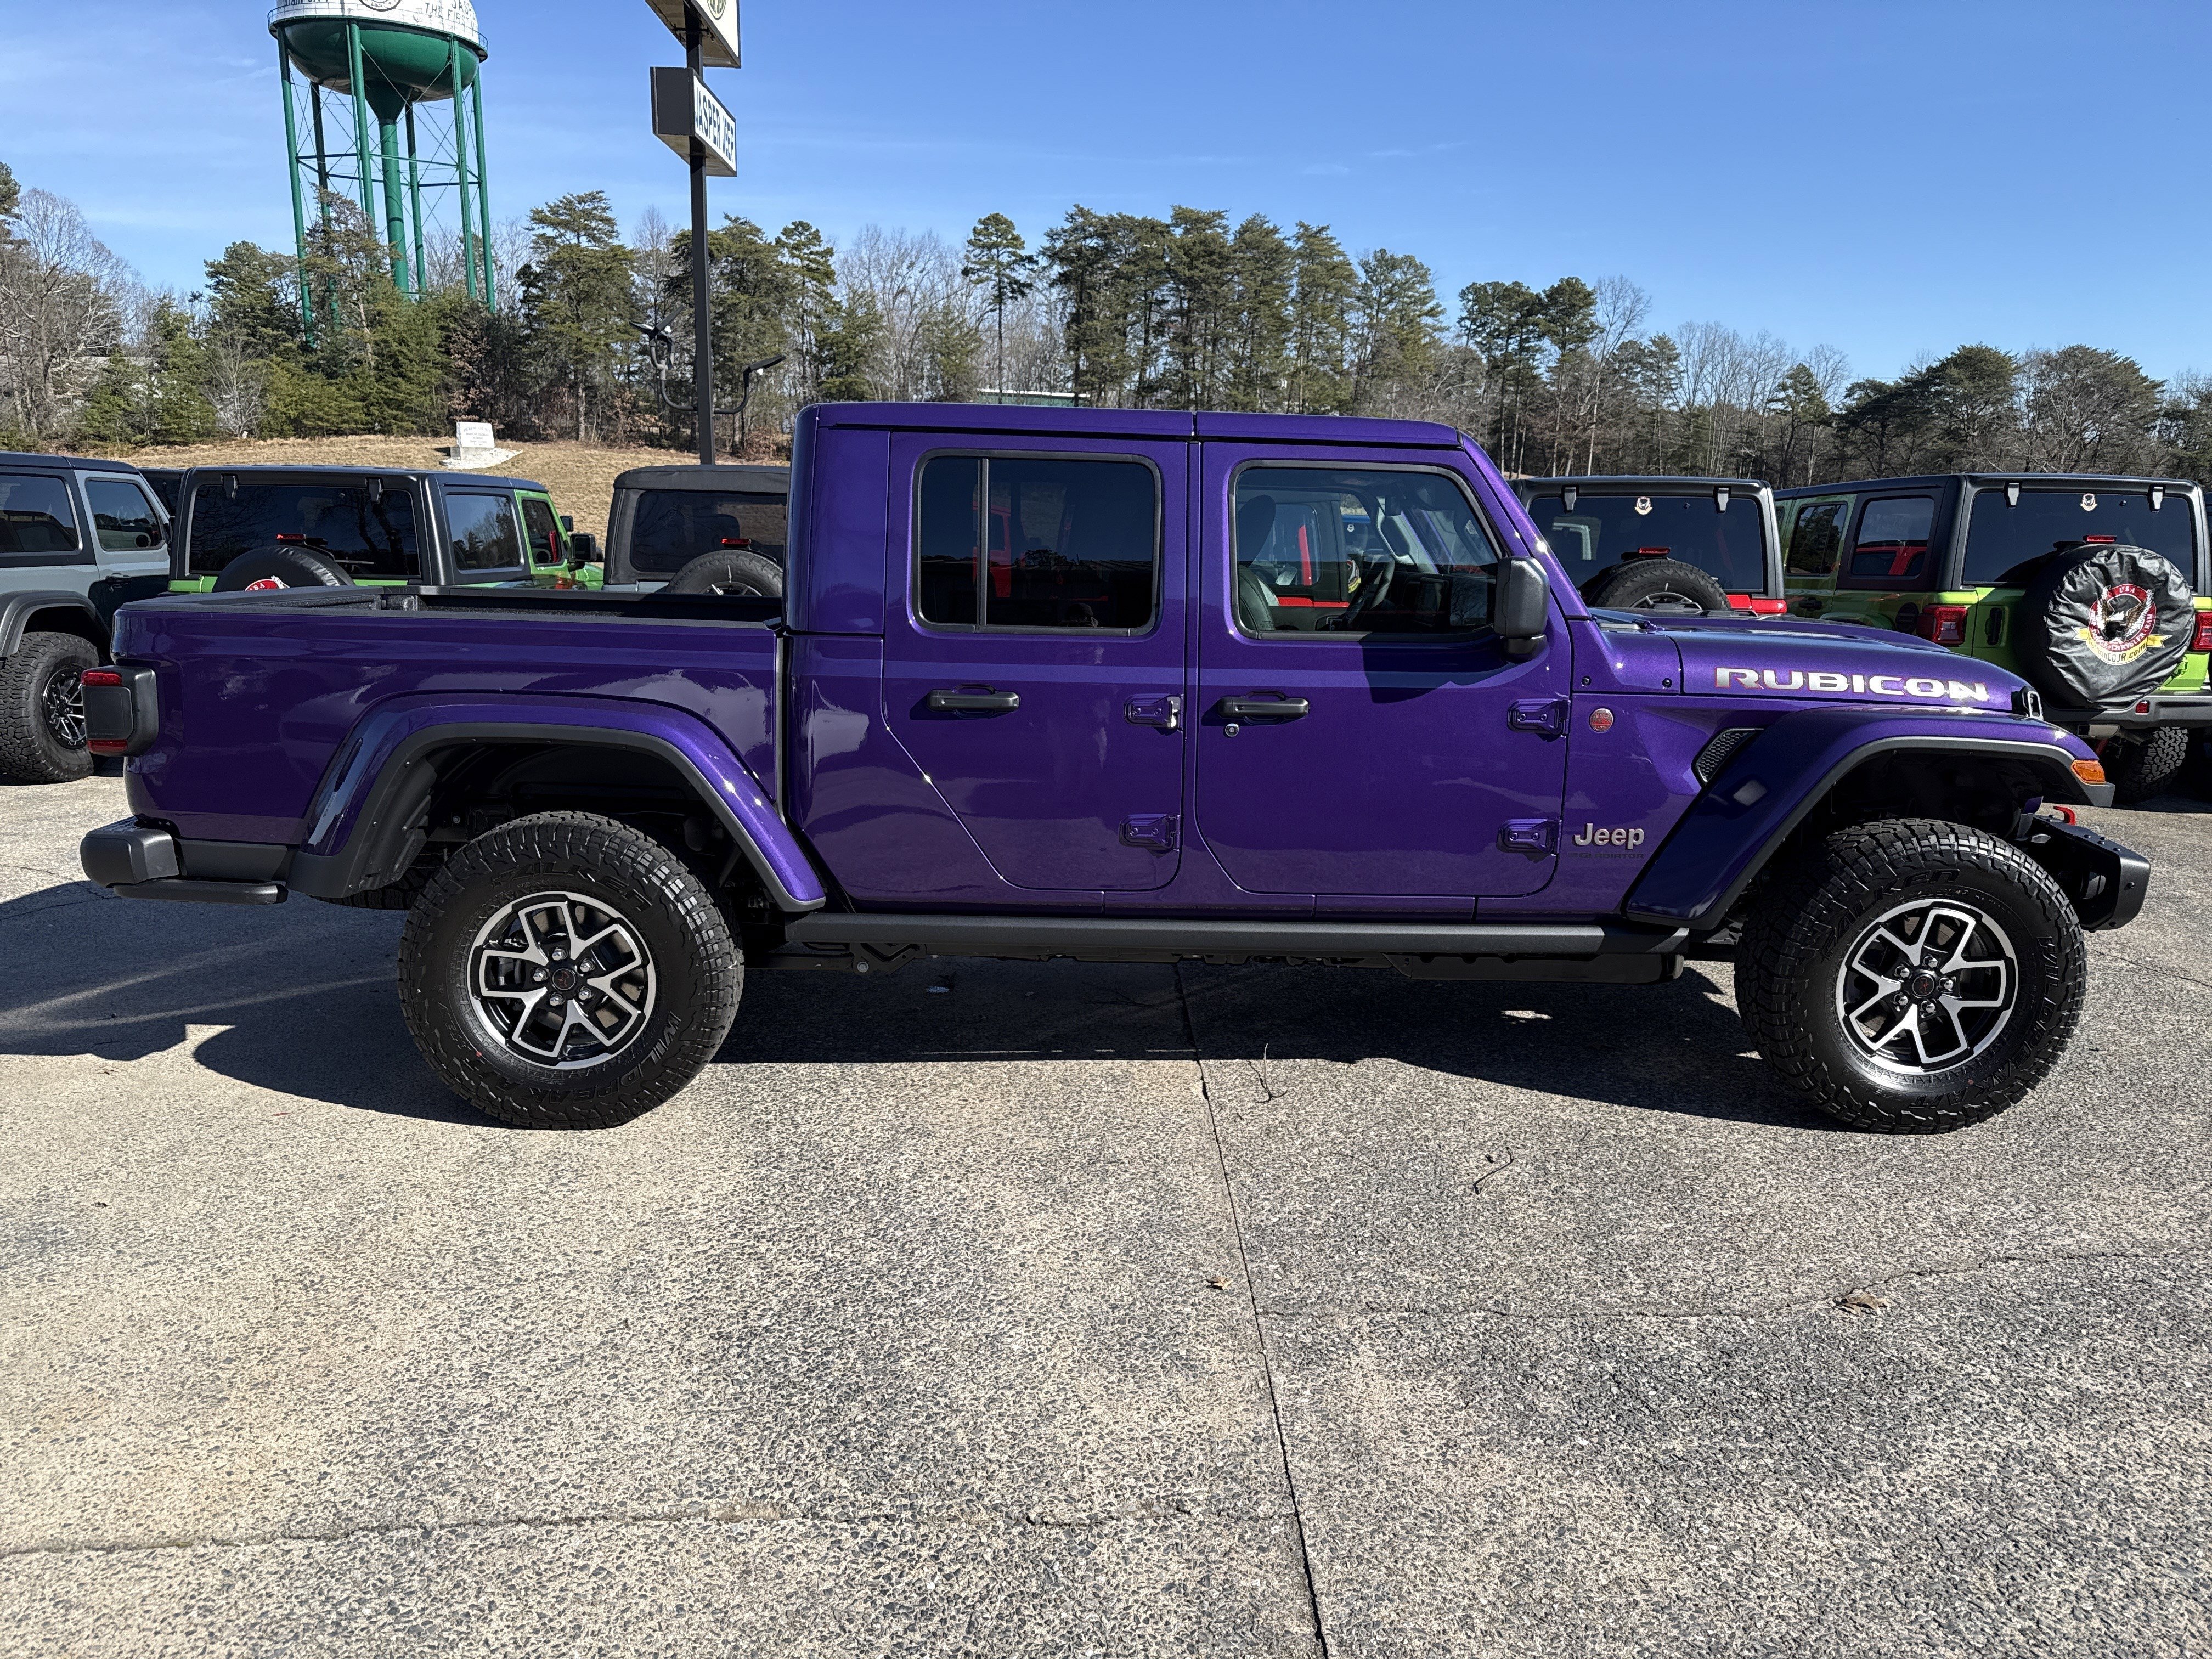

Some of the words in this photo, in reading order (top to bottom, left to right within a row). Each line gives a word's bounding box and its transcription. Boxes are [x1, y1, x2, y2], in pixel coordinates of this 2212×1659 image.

[425, 2, 443, 18] THE
[448, 9, 469, 27] FIRST
[695, 87, 721, 150] JASPER
[723, 115, 734, 163] JEEP
[2111, 633, 2147, 651] CHRYSLER
[1714, 667, 1989, 702] RUBICON
[1573, 823, 1645, 850] Jeep
[1974, 936, 2059, 1098] WILDPEAK
[527, 1011, 682, 1104] WILDPEAK
